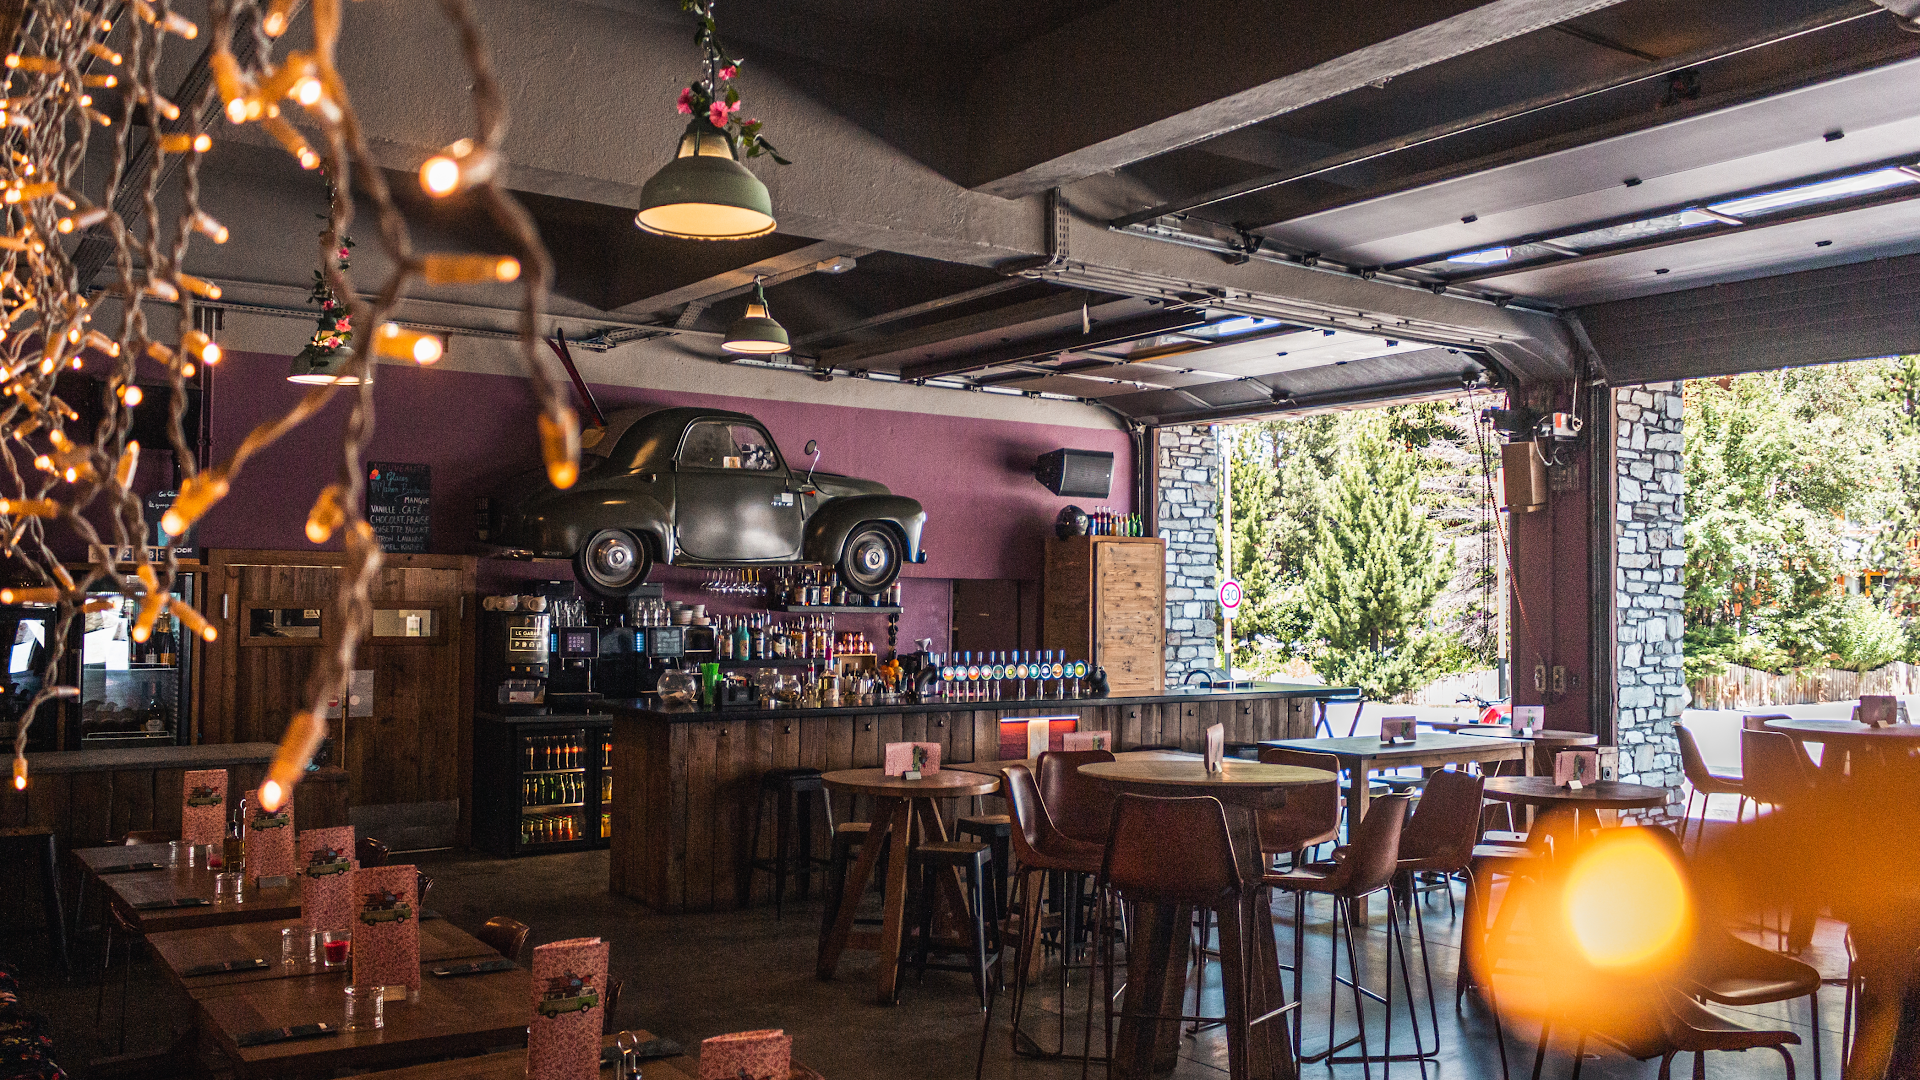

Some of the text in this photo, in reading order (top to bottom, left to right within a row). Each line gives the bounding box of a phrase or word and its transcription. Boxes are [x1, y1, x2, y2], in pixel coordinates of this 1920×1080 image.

[404, 496, 430, 505] MANGUE
[370, 505, 396, 514] VANILLE
[1224, 588, 1238, 600] 30
